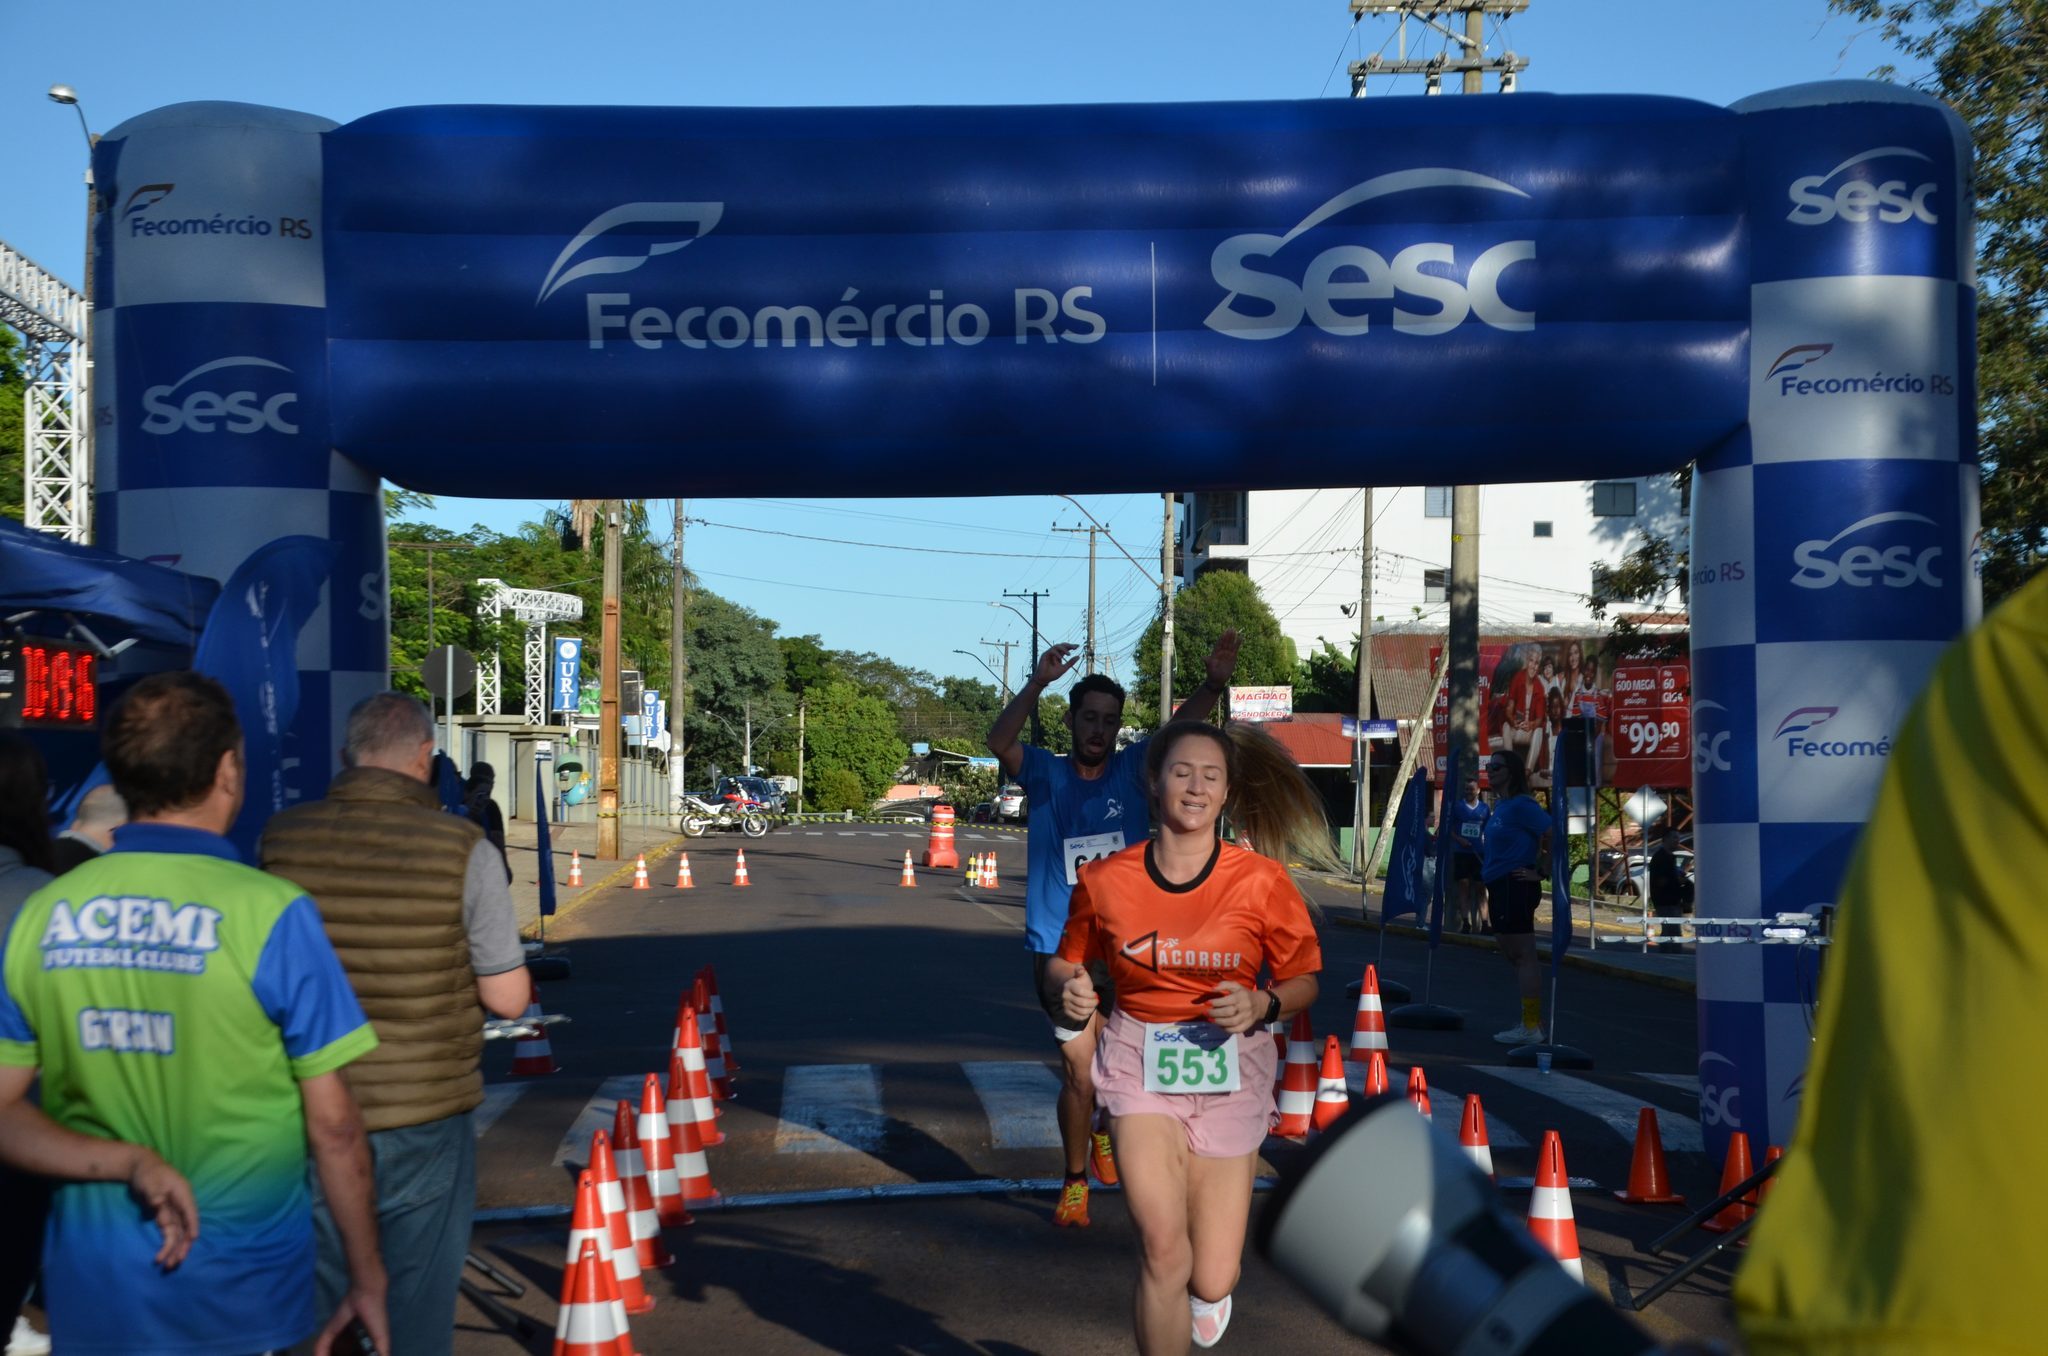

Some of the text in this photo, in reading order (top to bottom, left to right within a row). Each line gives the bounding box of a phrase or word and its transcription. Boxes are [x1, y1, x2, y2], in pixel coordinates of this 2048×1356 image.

[131, 212, 312, 240] Fecomércio RS
[586, 286, 1107, 350] Fecomércio RS
[1780, 371, 1954, 397] Fecomércio RS
[1720, 561, 1745, 582] RS
[560, 661, 575, 709] URI
[1616, 679, 1656, 691] 600 MEGA
[1663, 678, 1675, 689] 60
[644, 705, 654, 737] URI
[1788, 735, 1891, 757] Fecomé
[41, 896, 222, 950] ACEMI
[1157, 1047, 1228, 1086] 553
